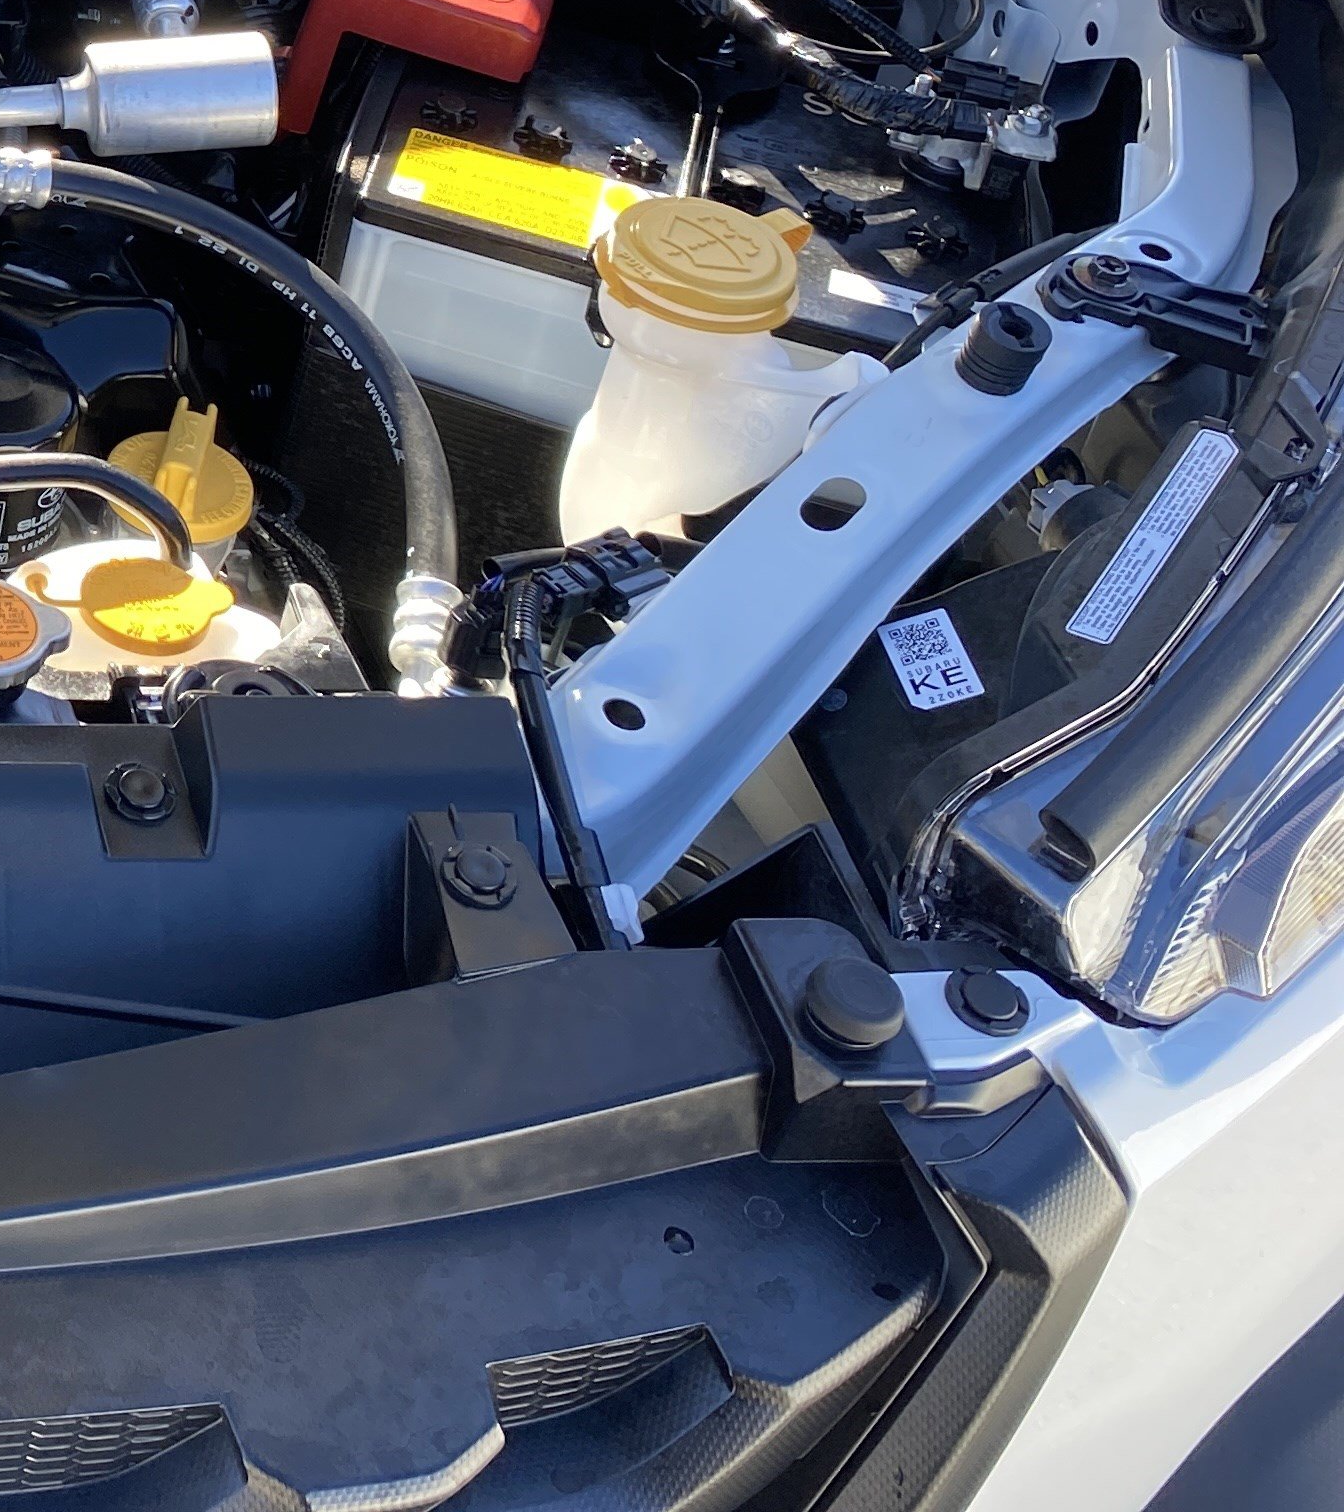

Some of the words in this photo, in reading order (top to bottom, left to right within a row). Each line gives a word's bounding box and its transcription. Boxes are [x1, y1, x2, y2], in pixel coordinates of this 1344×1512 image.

[405, 154, 457, 174] POISON
[198, 235, 228, 255] 22
[615, 251, 653, 280] PULL
[271, 279, 297, 301] HP
[300, 302, 317, 320] 11
[364, 377, 399, 446] YOKOHAMA
[906, 656, 962, 678] SUBARU
[909, 665, 969, 695] KE
